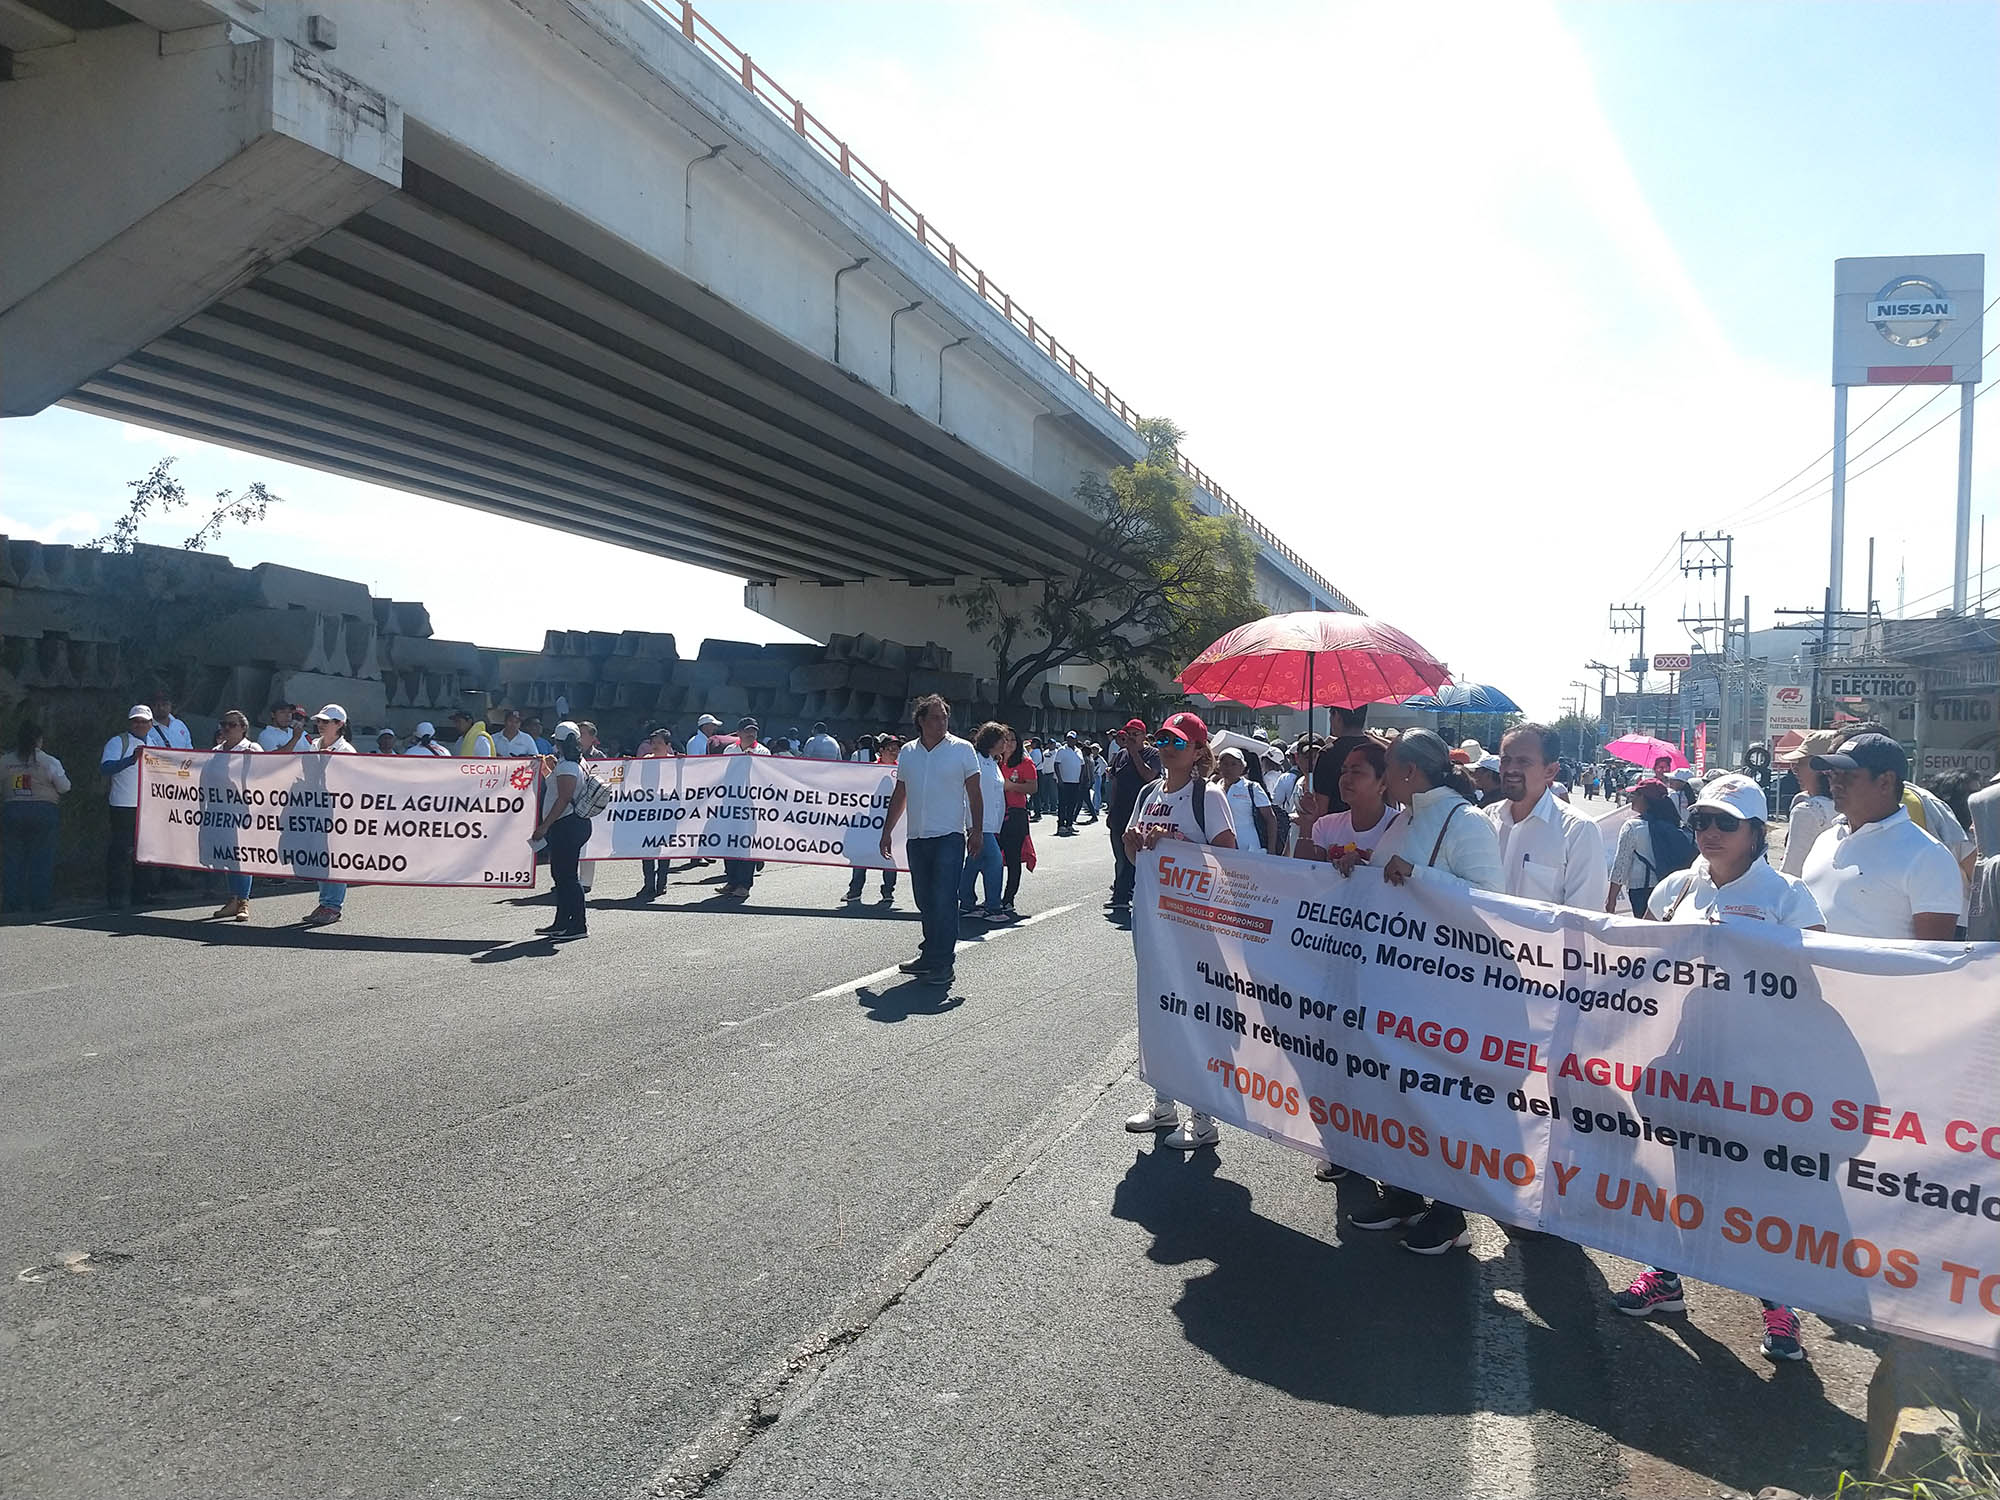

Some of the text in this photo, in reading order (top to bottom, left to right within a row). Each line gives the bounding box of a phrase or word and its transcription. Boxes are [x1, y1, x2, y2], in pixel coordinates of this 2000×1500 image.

[1877, 303, 1949, 317] NISSAN
[1655, 658, 1689, 667] OXXO
[1831, 679, 1917, 697] ELECTRICO
[180, 759, 193, 770] 19
[460, 764, 501, 776] CECATI
[611, 766, 624, 777] 19
[1924, 755, 1991, 771] SERVICIO
[479, 778, 499, 789] 147
[151, 783, 525, 814] EXIGIMOS EL PAGO COMPLETO DEL AGUINALDO
[660, 789, 680, 801] LA
[685, 784, 789, 802] DEVOLUCIÓN
[793, 789, 823, 805] DEL
[168, 808, 488, 839] AL GOBIERNO DEL ESTADO DE MORELOS.
[606, 805, 885, 830] INDEBIDO A NUESTRO AGUINALDO
[641, 833, 845, 855] MAESTRO HOMOLOGADO
[213, 845, 408, 872] MAESTRO HOMOLOGADO
[484, 871, 531, 883] D-II-93
[1158, 855, 1213, 894] SNTE
[1217, 877, 1250, 890] Nacional
[1220, 867, 1250, 881] Sindicato
[1213, 895, 1251, 909] Educación
[1216, 886, 1280, 905] Trabajadores de la
[1185, 905, 1215, 918] ORGULLO
[1216, 912, 1265, 930] COMPROMISO
[1297, 900, 1799, 1000] DELEGACIÓN SINDICAL D-II-96 CBTa 190
[1290, 927, 1659, 1016] Ocuituco, Morelos Homologados
[1299, 995, 1338, 1022] por
[1343, 1005, 1367, 1031] el
[1376, 1010, 1470, 1054] PAGO
[1479, 1034, 1548, 1073] DEL
[1558, 1052, 1814, 1123] AGUINALDO
[1830, 1098, 1927, 1146] SEA
[1159, 992, 1188, 1016] sin
[1193, 1001, 1210, 1023] el
[1215, 1005, 1247, 1036] ISR
[1252, 1021, 1339, 1067] retenido
[1346, 1052, 1391, 1080] por
[1400, 1067, 1496, 1105] parte
[1506, 1088, 1561, 1120] del
[1571, 1106, 1749, 1163] gobierno
[1763, 1144, 1831, 1183] del
[1309, 1095, 1431, 1158] SOMOS
[1439, 1135, 1536, 1188] UNO
[1551, 1160, 1582, 1197] Y
[1595, 1172, 1705, 1230] UNO
[1720, 1206, 1921, 1290] SOMOS
